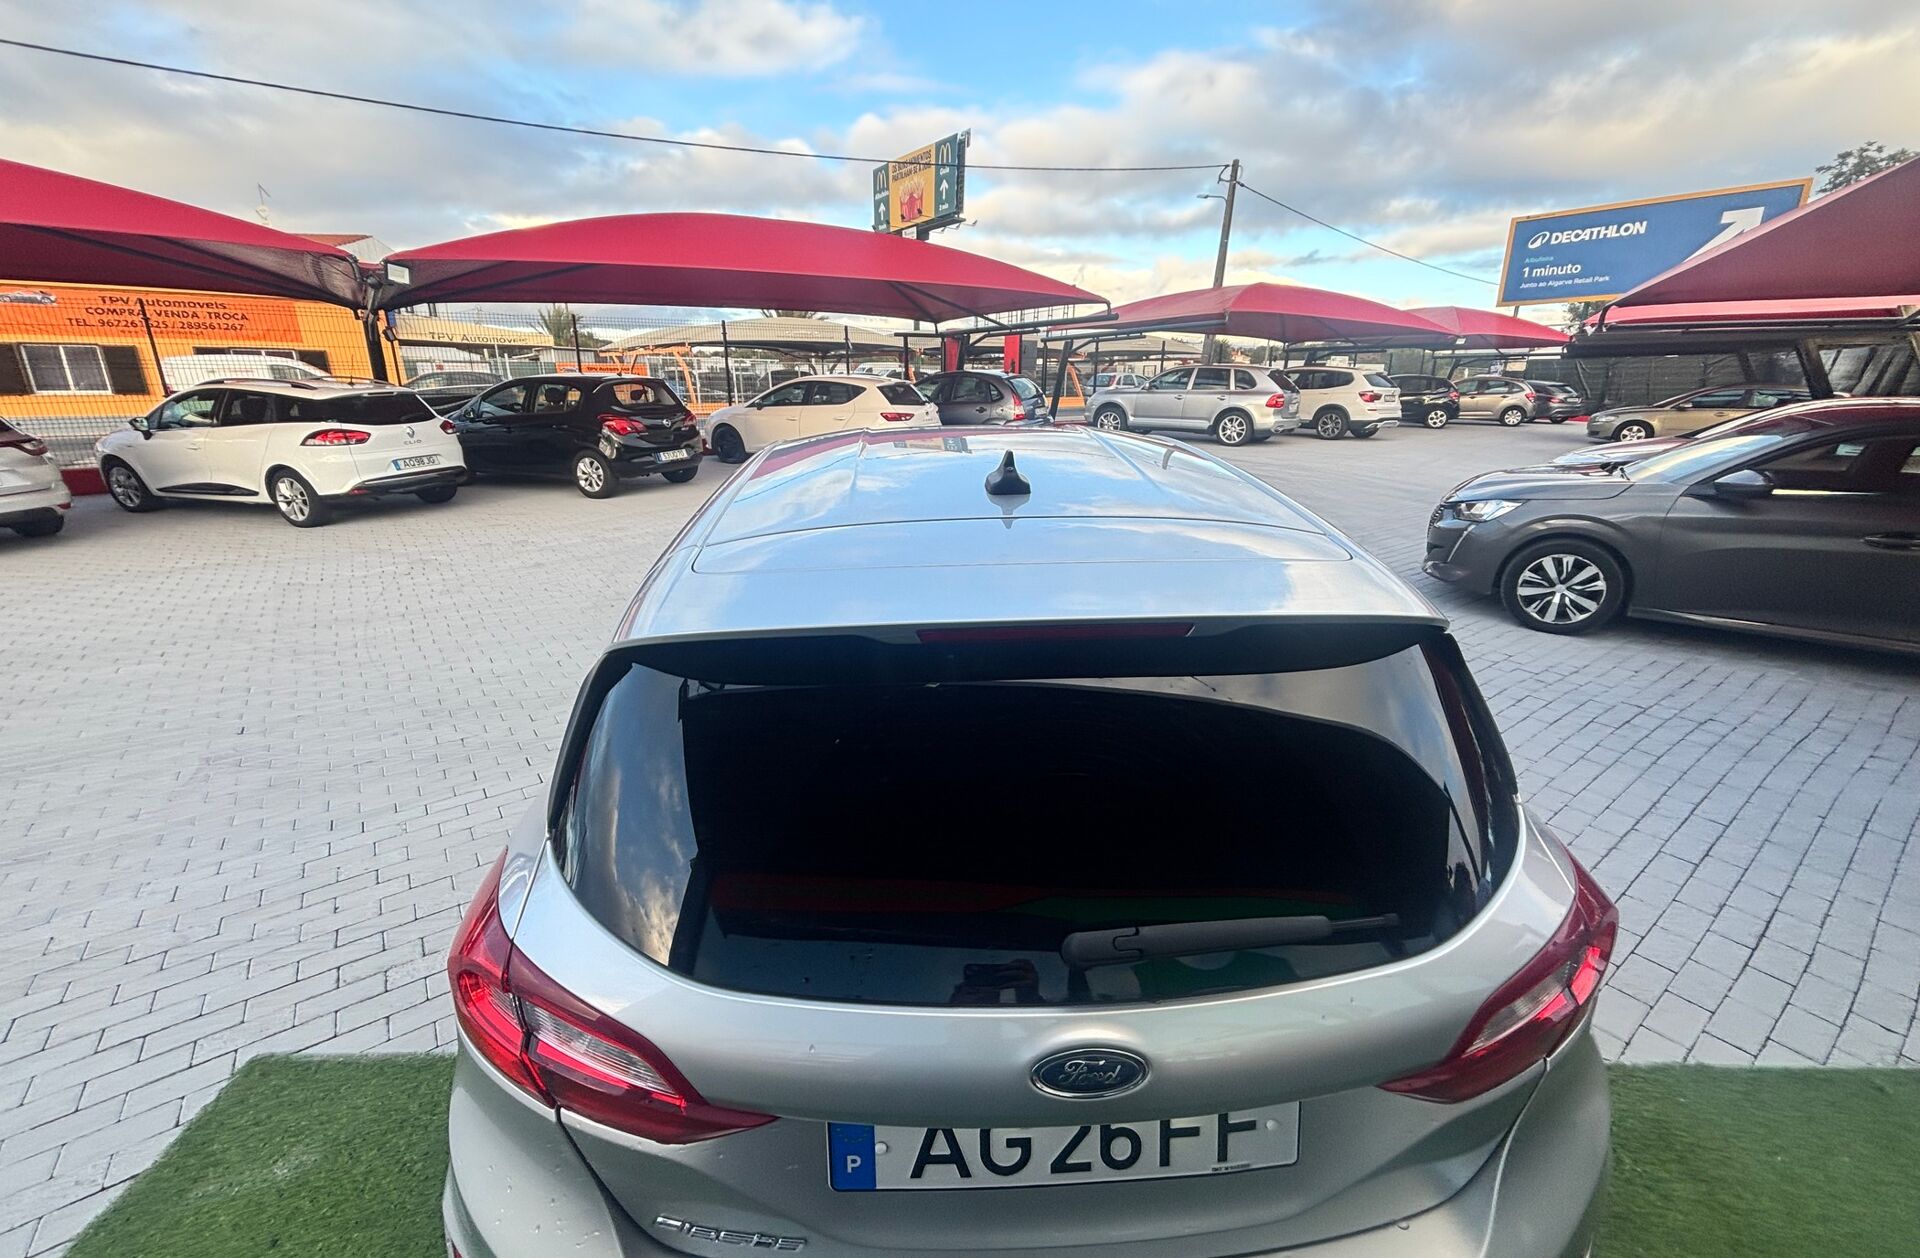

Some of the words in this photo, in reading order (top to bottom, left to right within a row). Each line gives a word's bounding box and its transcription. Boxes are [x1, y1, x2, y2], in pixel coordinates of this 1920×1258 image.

[1550, 221, 1648, 245] DECATHLON
[1522, 266, 1529, 278] 1
[1532, 263, 1582, 277] minuto
[1547, 279, 1572, 287] Algarve
[1573, 276, 1593, 284] Retail
[98, 295, 130, 305] TPV
[180, 321, 244, 331] 289561267
[428, 331, 455, 342] TPV
[1064, 1060, 1122, 1086] Ford
[846, 1155, 861, 1174] P
